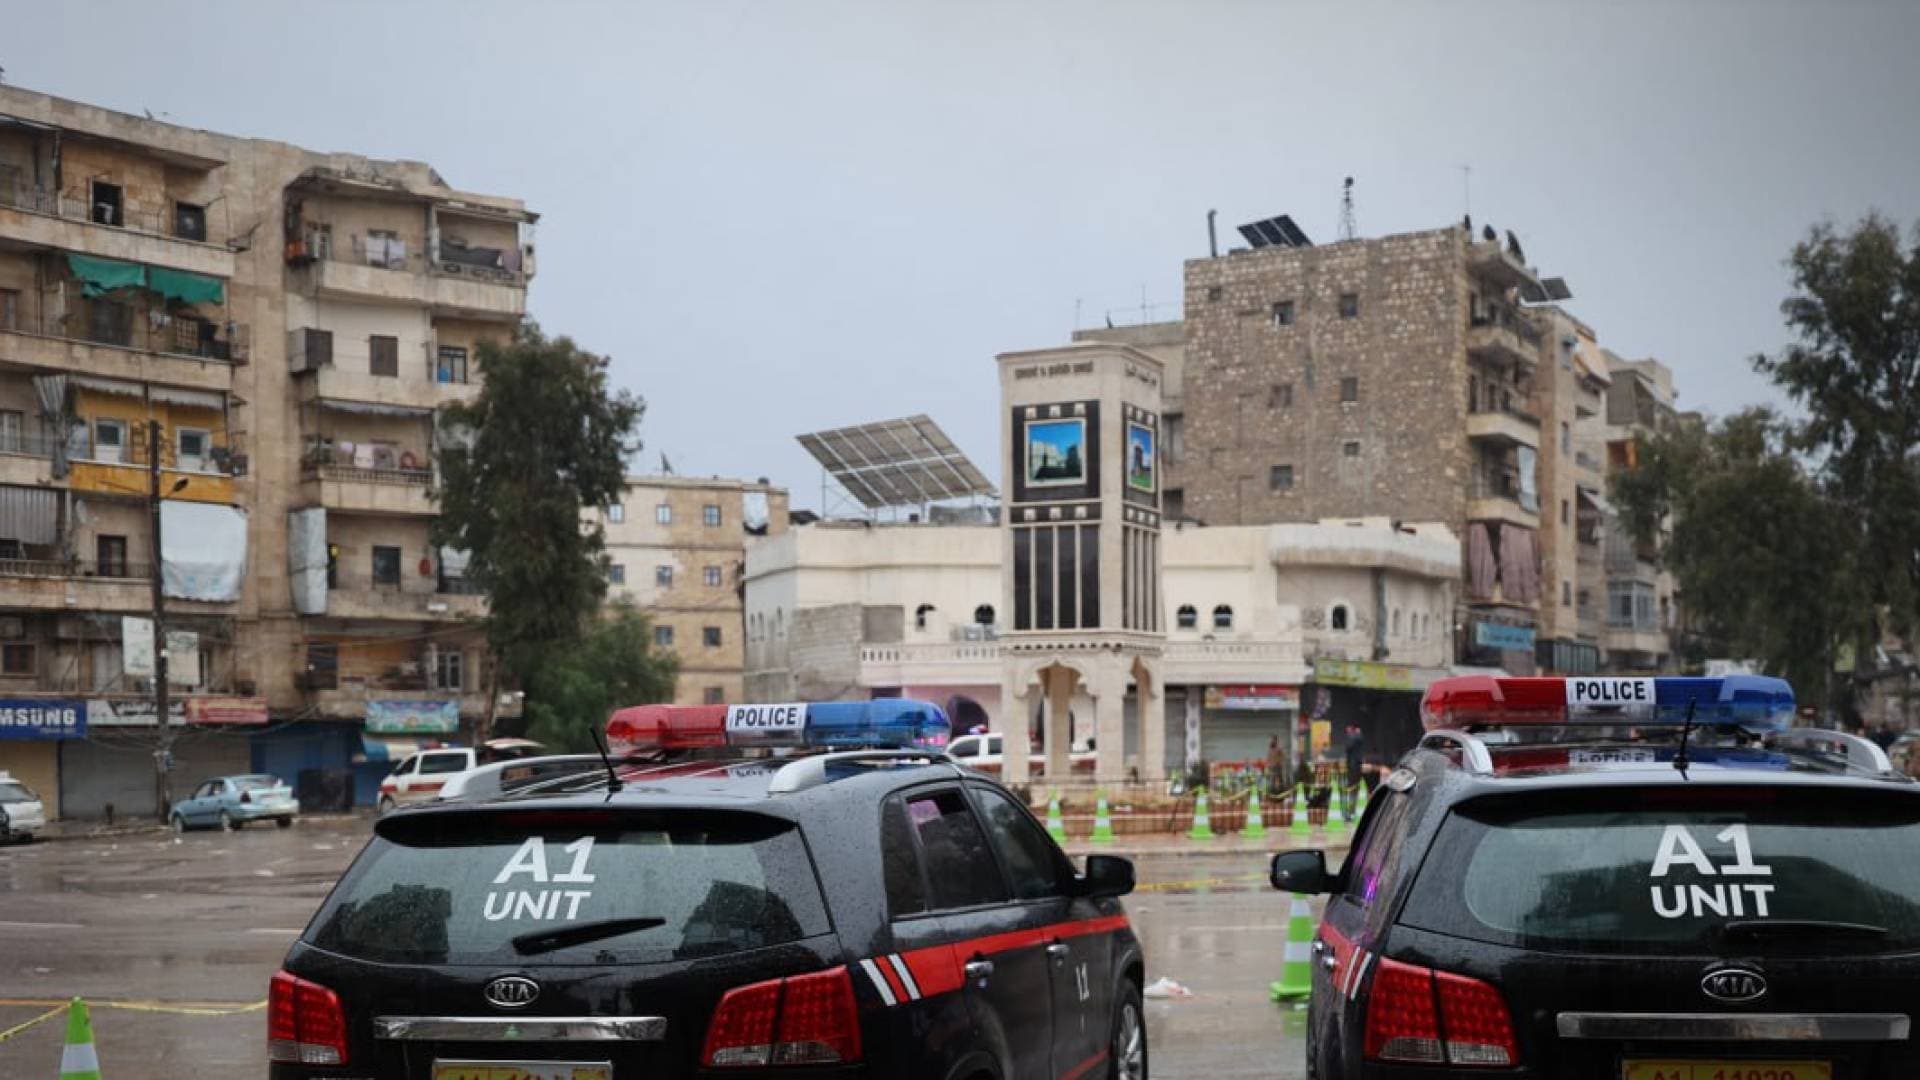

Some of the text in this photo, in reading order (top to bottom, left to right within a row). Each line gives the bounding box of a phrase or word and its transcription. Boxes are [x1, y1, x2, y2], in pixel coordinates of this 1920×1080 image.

[1576, 680, 1646, 700] POLICE
[734, 707, 798, 727] POLICE
[493, 836, 596, 883] A1
[1650, 824, 1772, 876] A1
[483, 890, 592, 920] UNIT
[1650, 884, 1775, 918] UNIT
